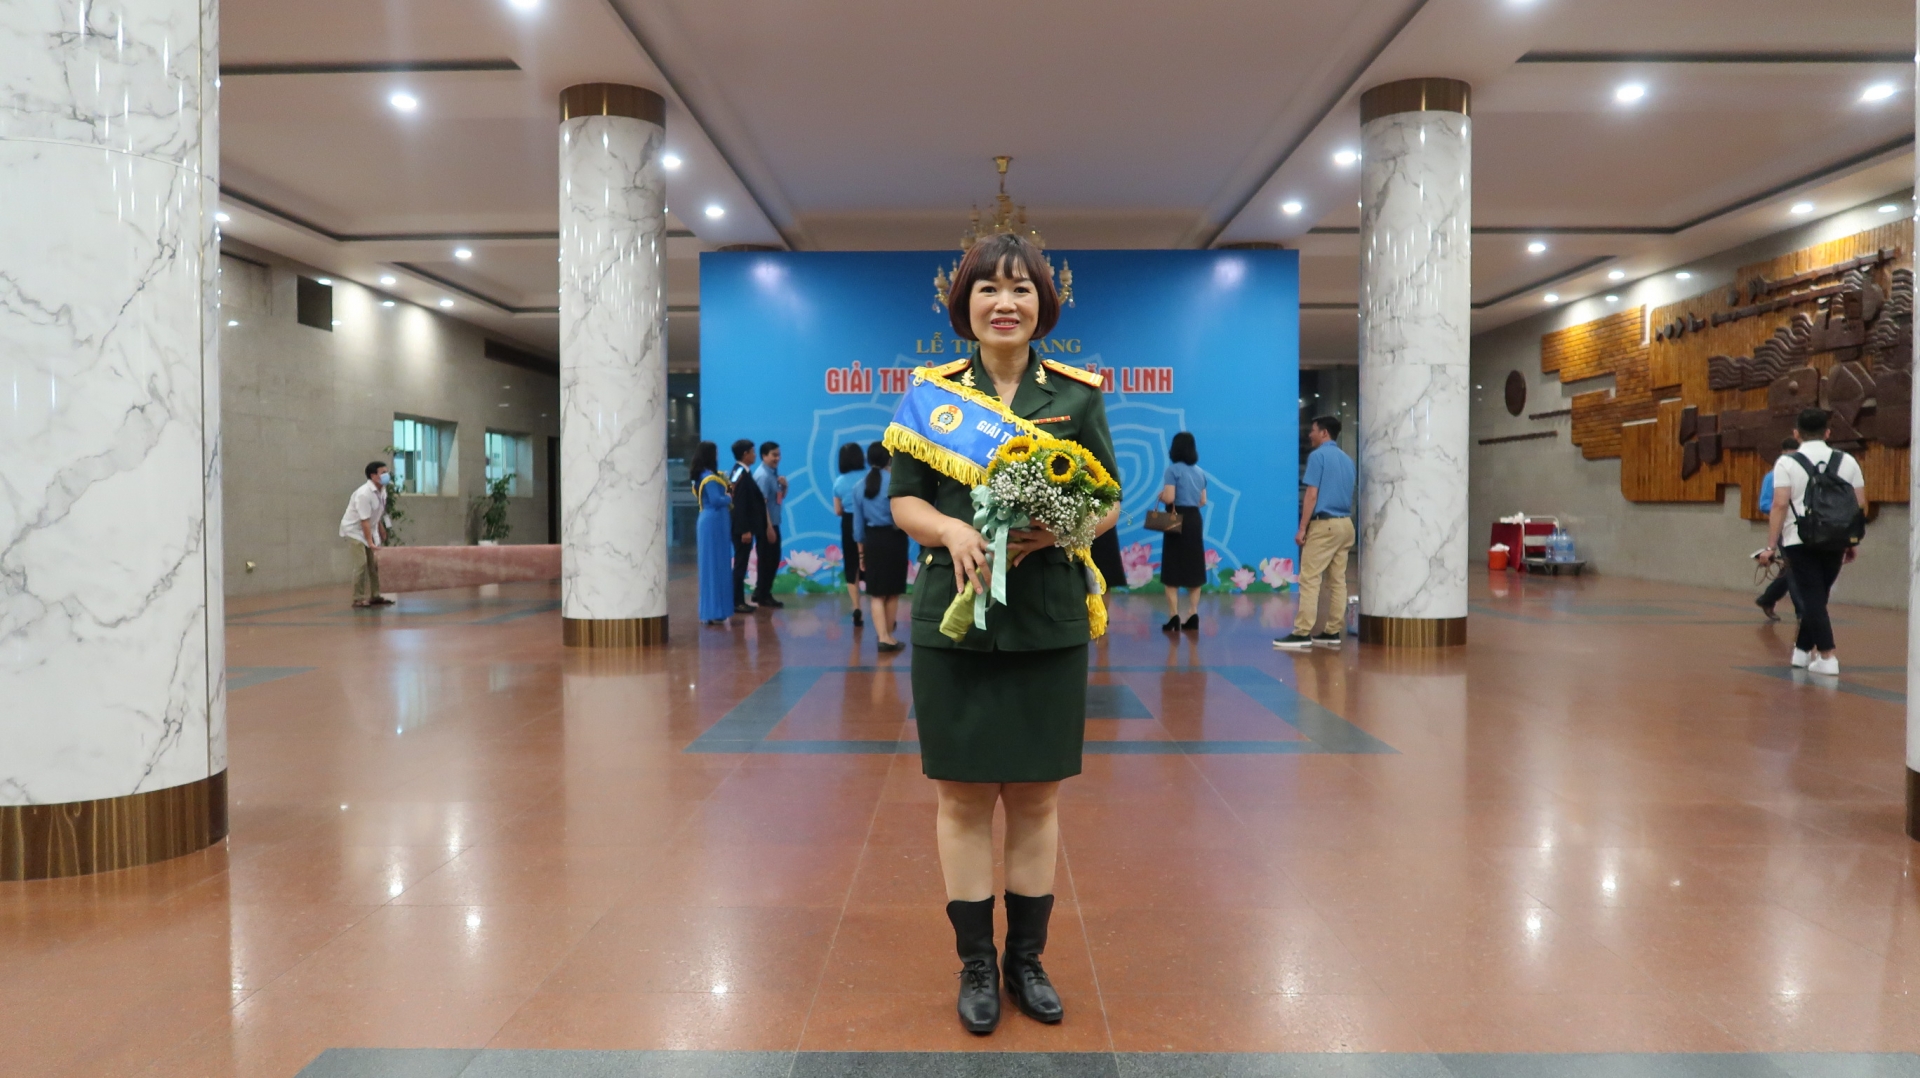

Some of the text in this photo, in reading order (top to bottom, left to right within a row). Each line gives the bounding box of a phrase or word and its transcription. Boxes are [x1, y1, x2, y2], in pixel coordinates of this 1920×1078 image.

[916, 332, 1082, 356] LỄ TR ẶNG
[826, 360, 872, 394] GIẢI
[1122, 367, 1173, 393] LINH
[976, 420, 1001, 439] GIẢI
